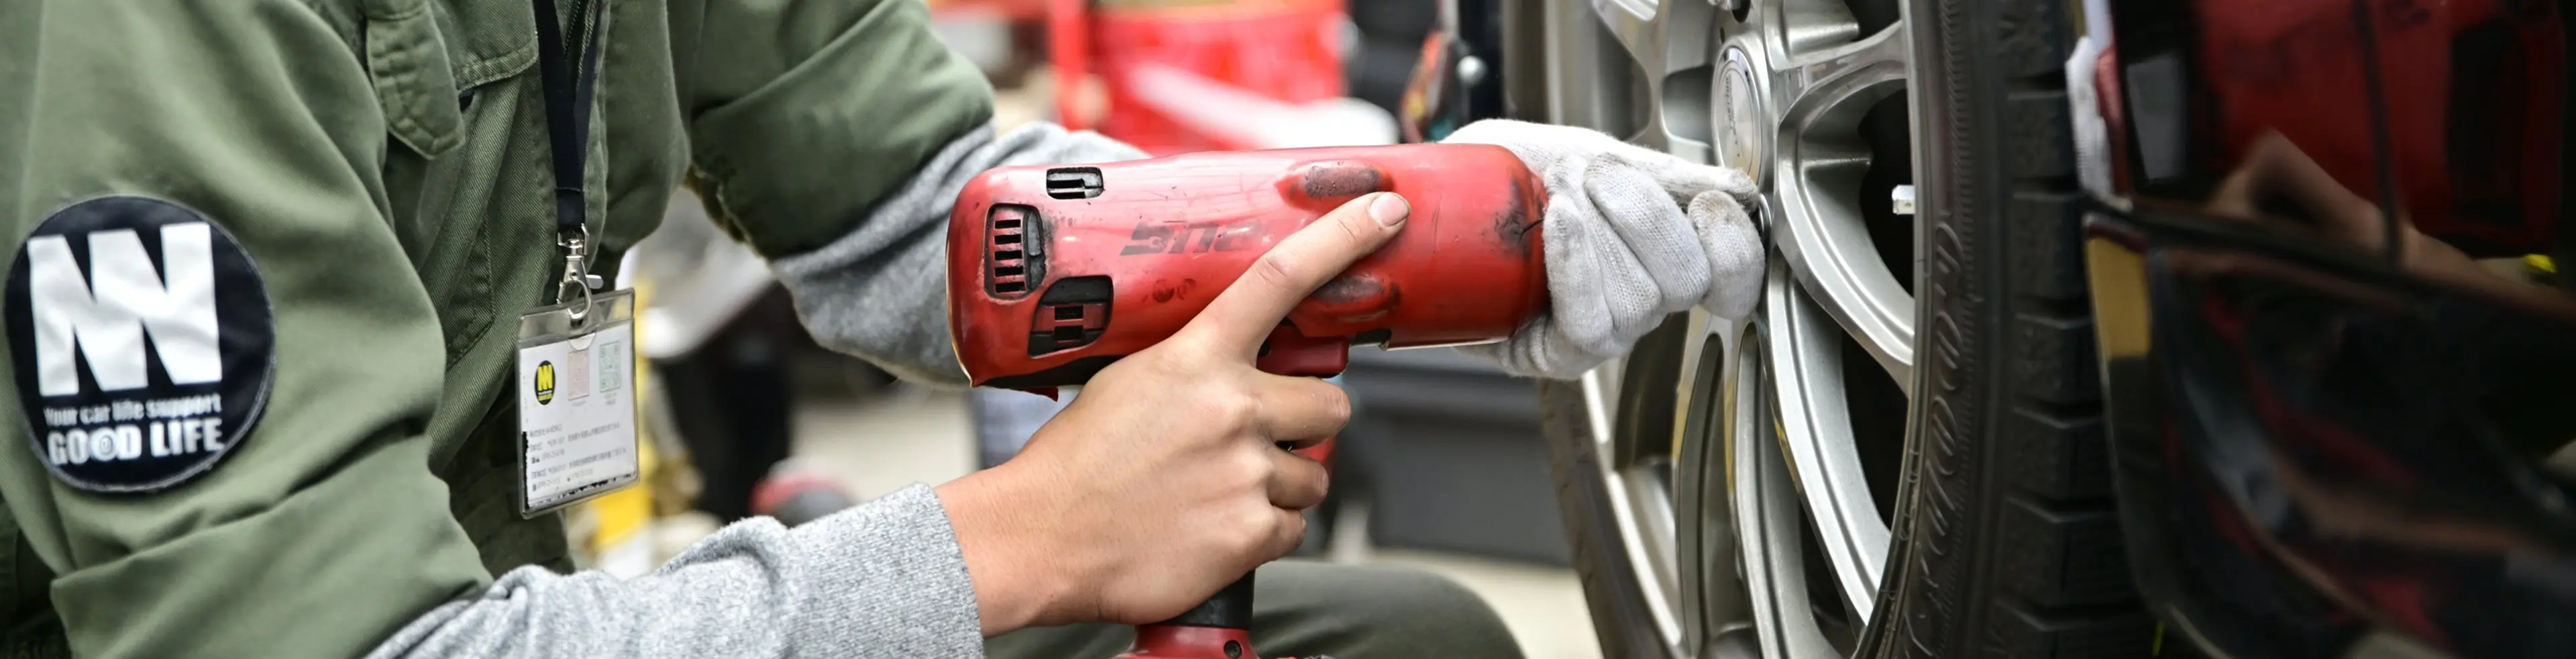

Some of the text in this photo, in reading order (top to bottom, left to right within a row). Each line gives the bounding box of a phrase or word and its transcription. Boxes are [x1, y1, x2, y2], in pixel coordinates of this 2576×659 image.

[44, 393, 221, 426] Your car life support
[48, 417, 225, 465] GOOD LIFE
